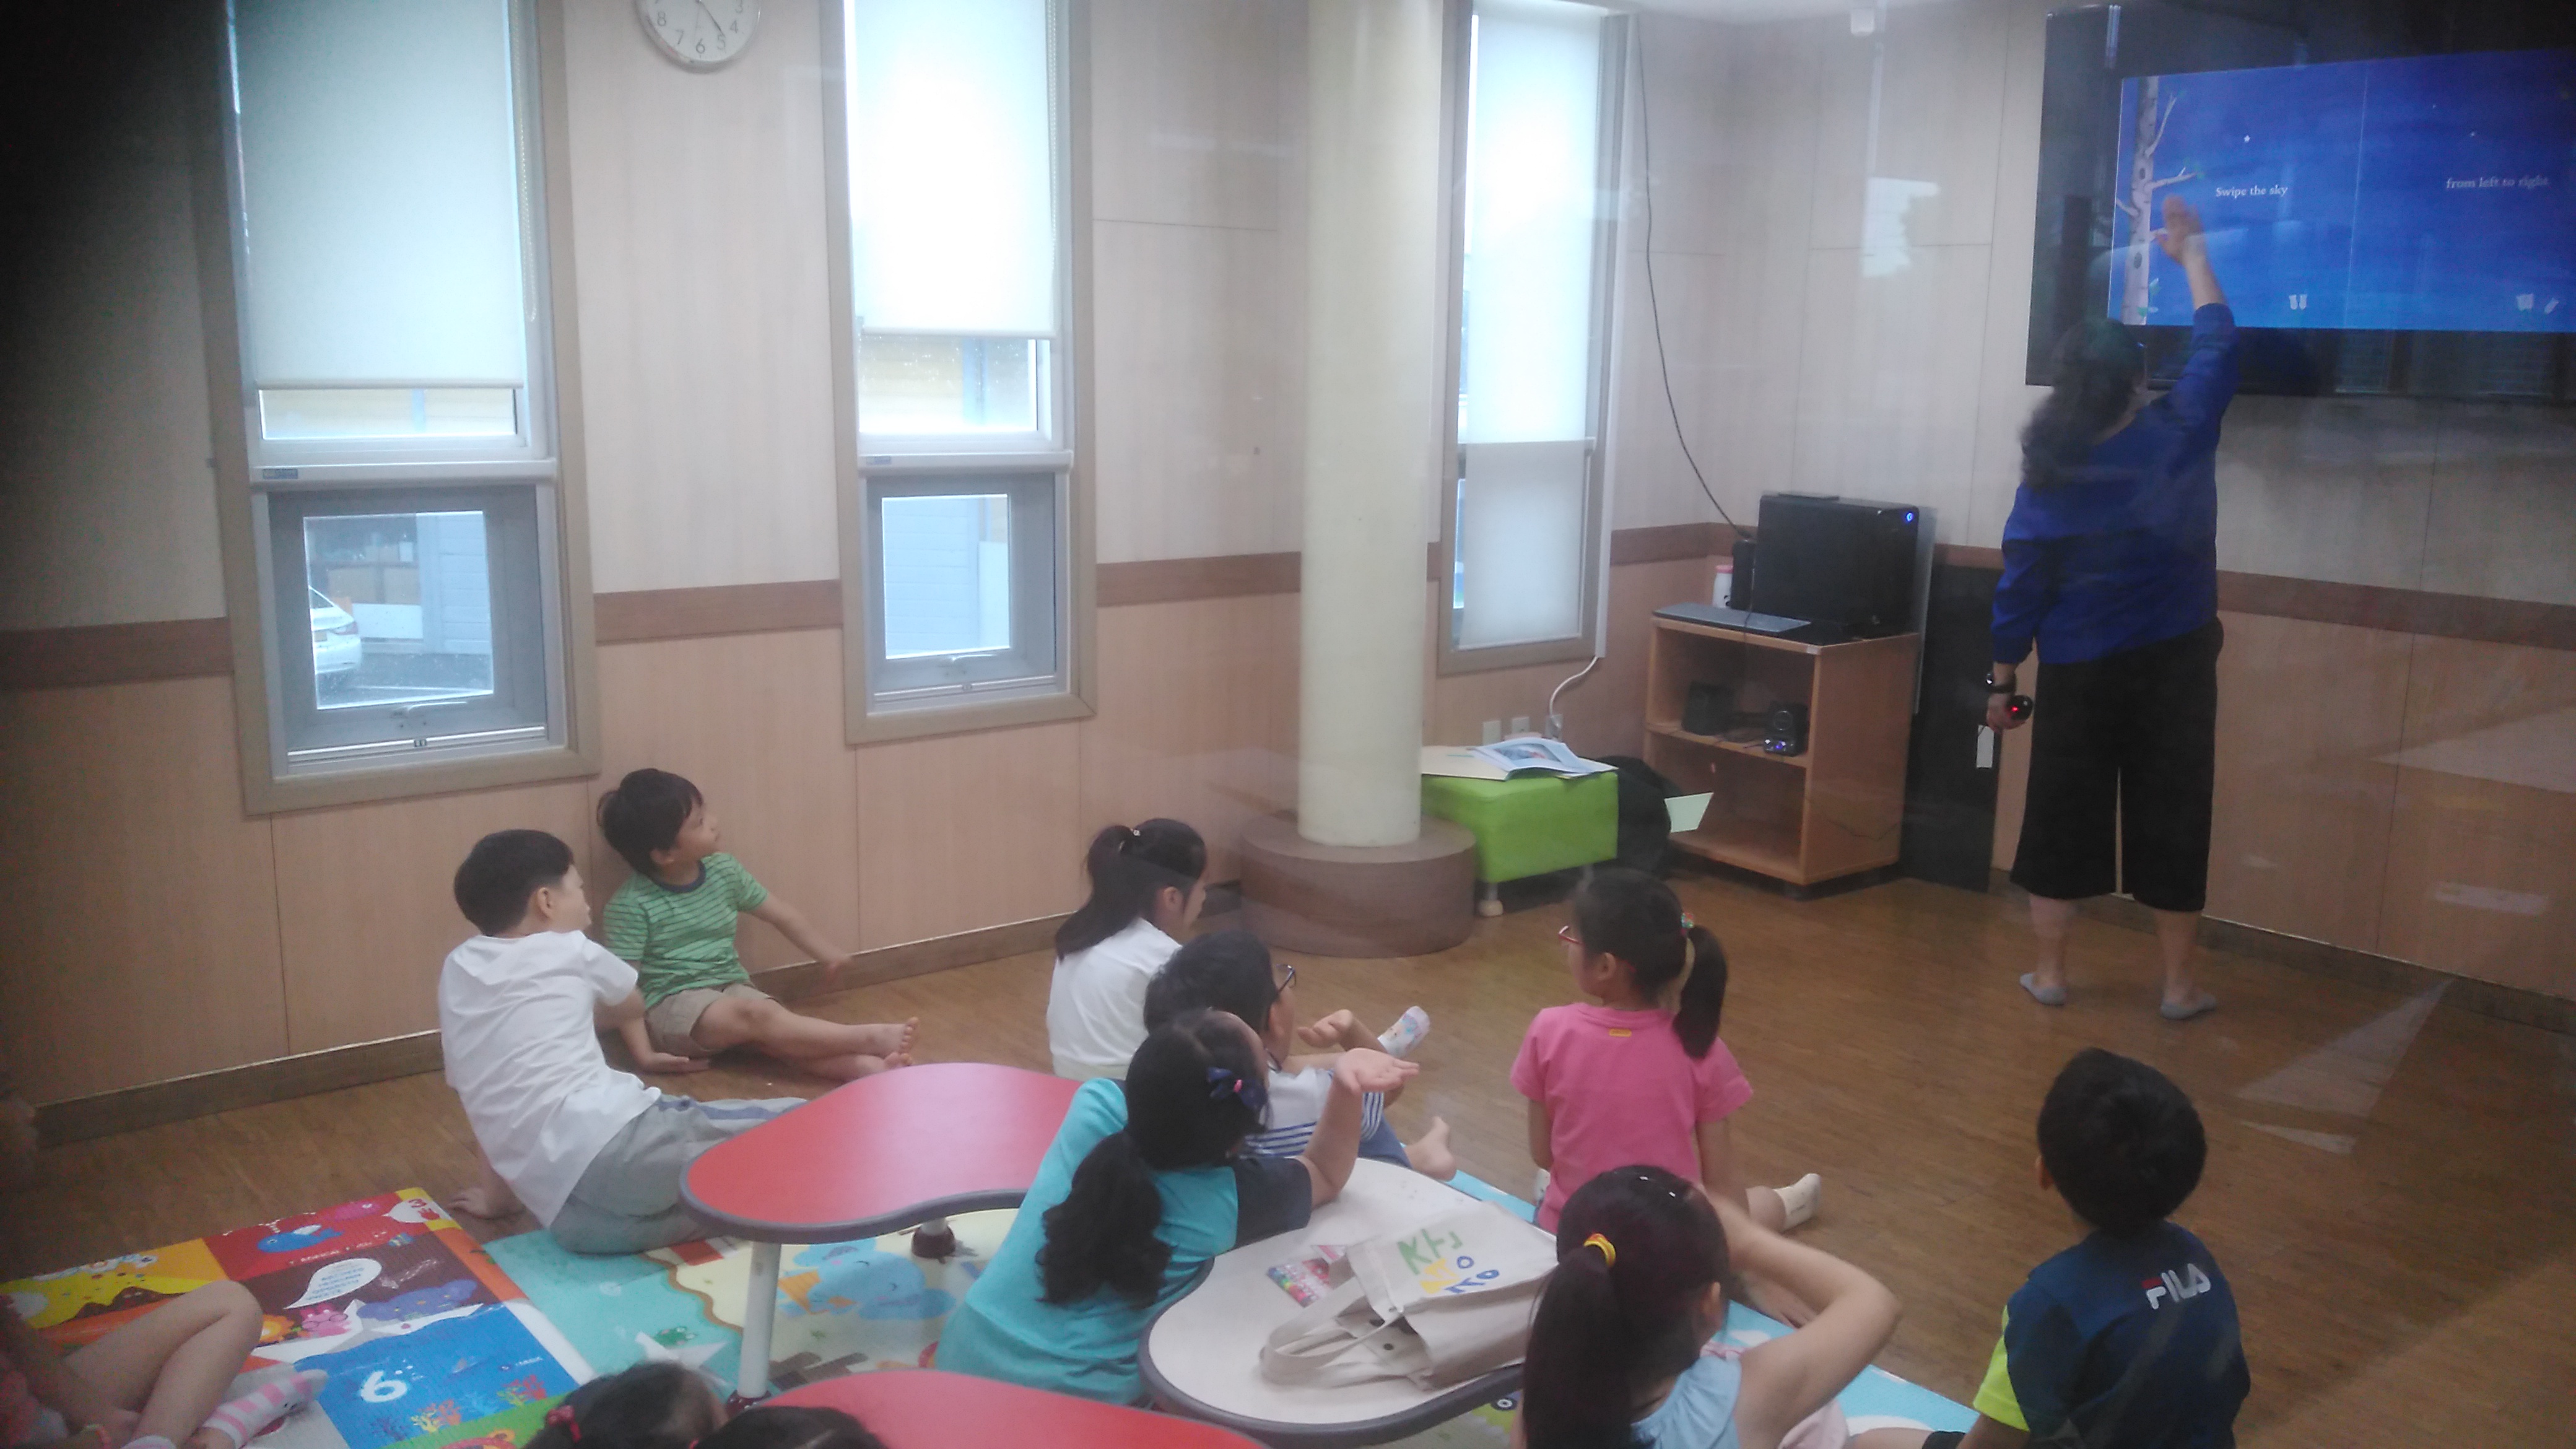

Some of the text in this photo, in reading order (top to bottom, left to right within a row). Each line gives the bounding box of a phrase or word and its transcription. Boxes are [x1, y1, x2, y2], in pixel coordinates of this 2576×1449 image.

[657, 11, 666, 26] 8
[729, 20, 739, 33] 4
[676, 29, 684, 45] 7
[717, 33, 726, 50] 5
[696, 38, 705, 54] 6
[2446, 175, 2549, 189] from left to right
[2216, 185, 2288, 198] Swipe the sky
[2141, 1263, 2211, 1310] FILA
[360, 1370, 408, 1403] 6
